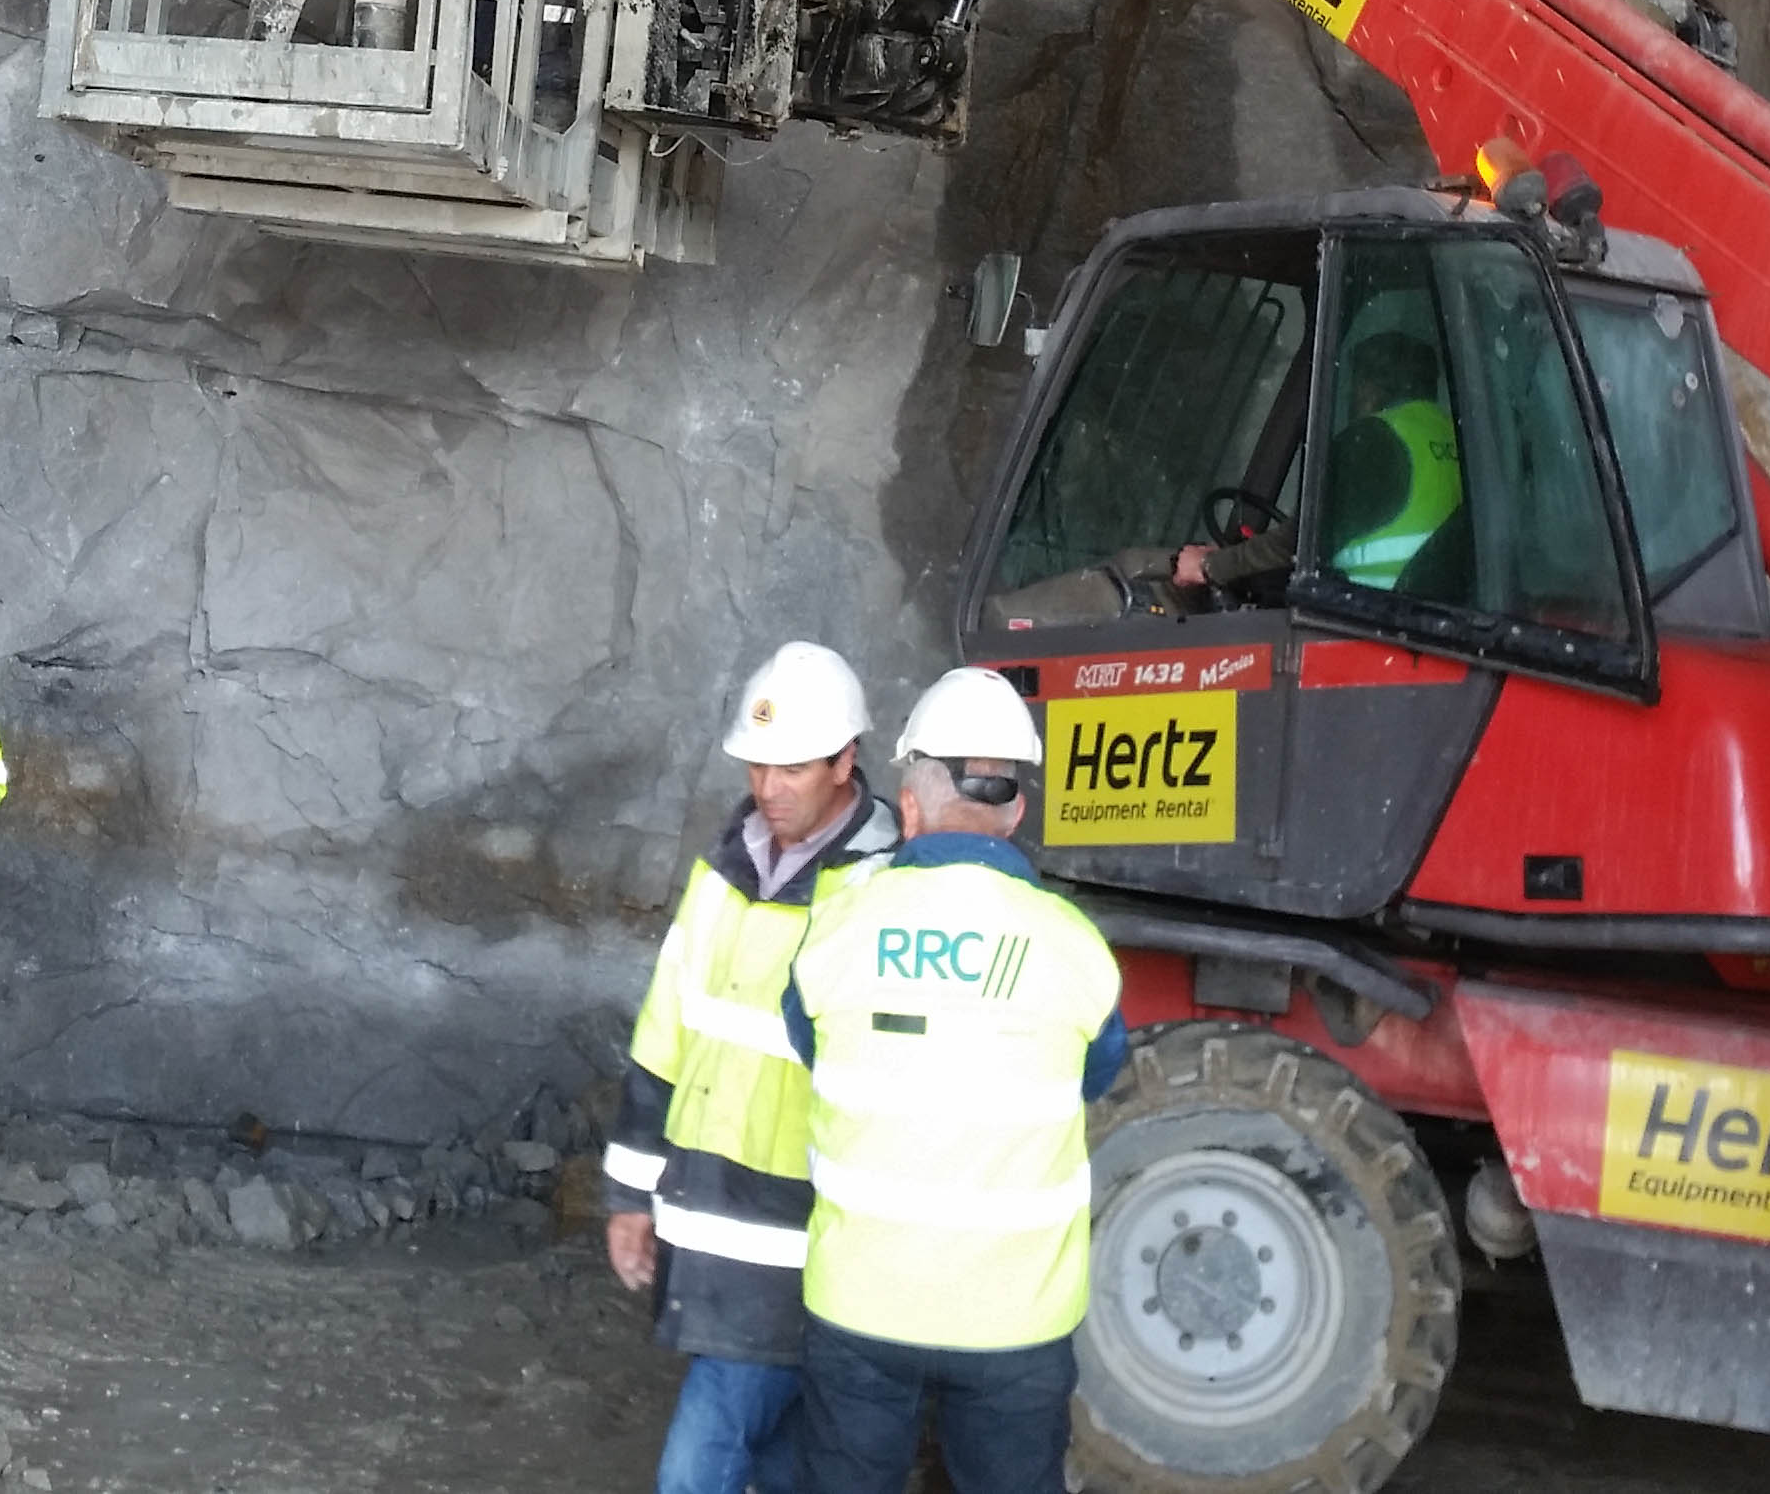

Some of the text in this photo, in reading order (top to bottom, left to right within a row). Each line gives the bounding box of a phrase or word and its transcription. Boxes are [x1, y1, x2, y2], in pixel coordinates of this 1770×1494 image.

[1075, 662, 1127, 689] MRT
[1134, 662, 1185, 685] 1432
[1065, 718, 1218, 792] Hertz
[1060, 798, 1210, 824] Equipment Rental
[877, 928, 984, 982] RRC
